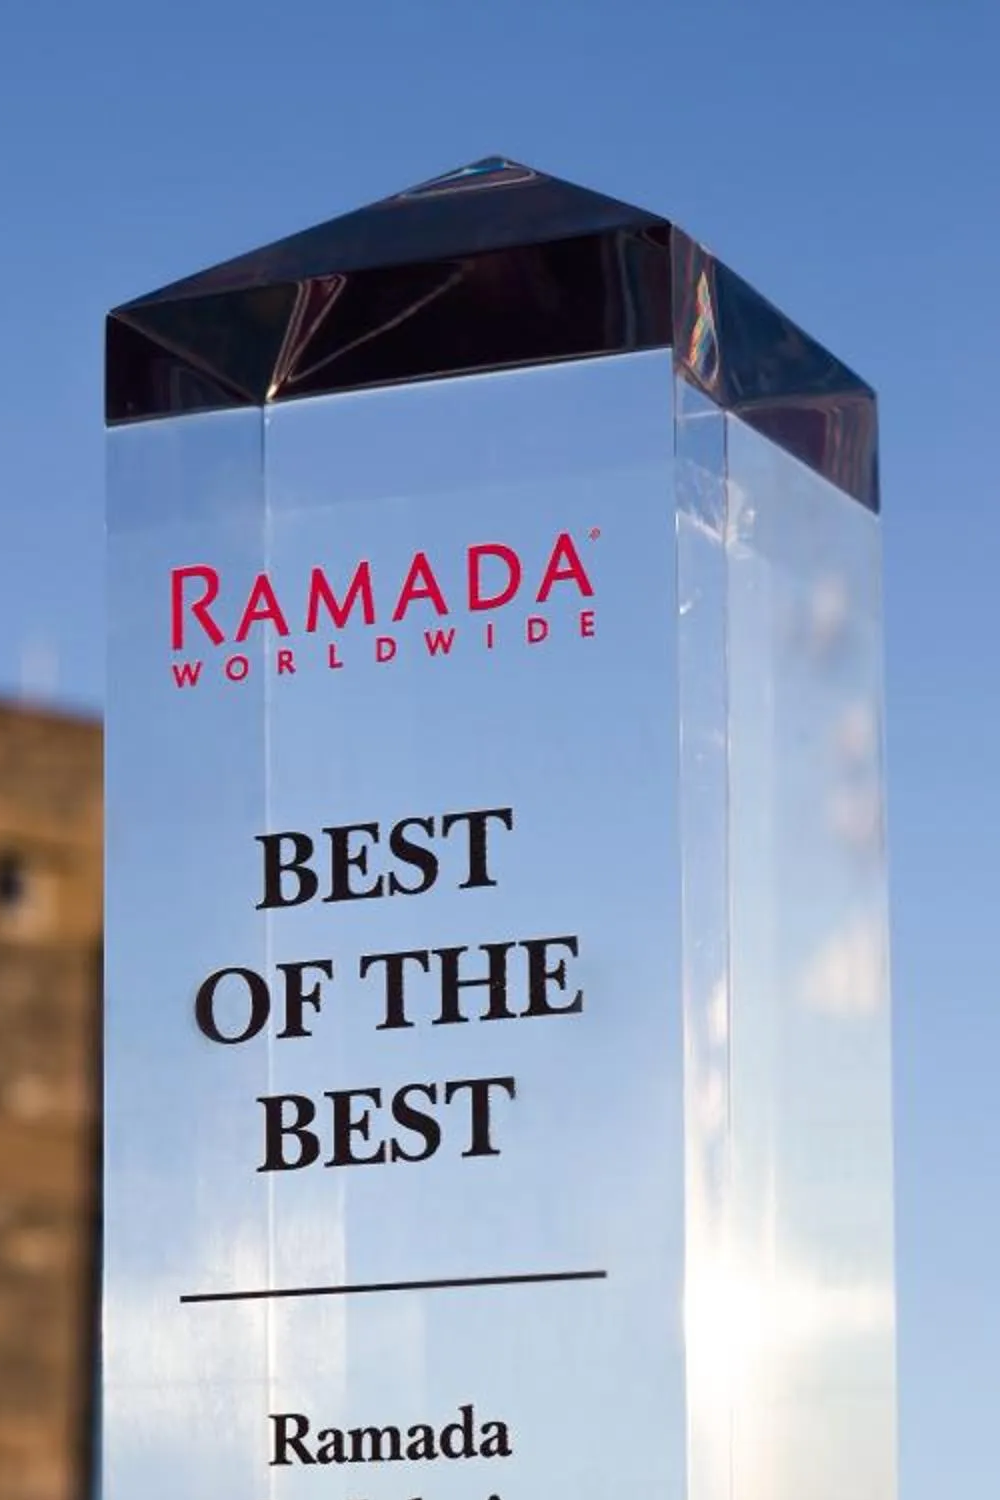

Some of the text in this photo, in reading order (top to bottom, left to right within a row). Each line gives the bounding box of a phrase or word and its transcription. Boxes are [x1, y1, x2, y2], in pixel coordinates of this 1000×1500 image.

[172, 532, 595, 651] RAMADA
[172, 610, 597, 689] WORLDWIDE
[254, 808, 514, 911] BEST
[194, 936, 584, 1045] OF THE
[256, 1076, 517, 1174] BEST
[268, 1404, 513, 1467] Ramada
